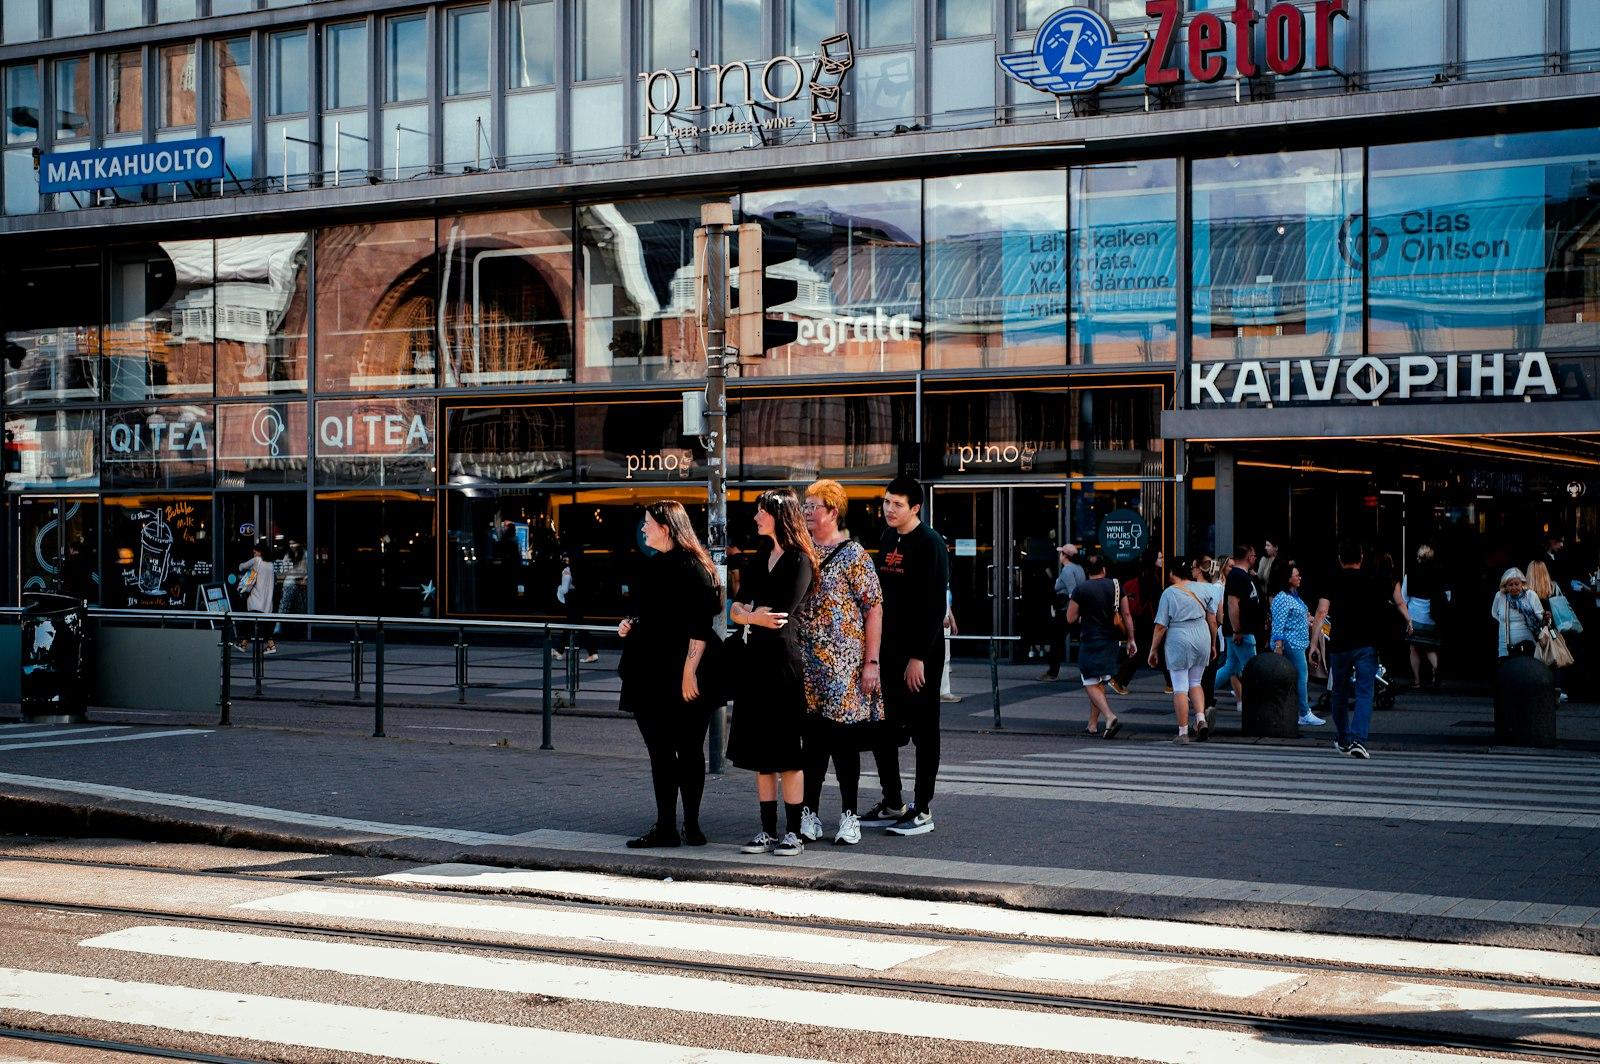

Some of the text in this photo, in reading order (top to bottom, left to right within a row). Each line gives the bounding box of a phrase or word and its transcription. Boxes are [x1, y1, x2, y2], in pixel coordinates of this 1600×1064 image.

[1145, 0, 1349, 85] Zetor
[638, 49, 804, 141] pino
[672, 126, 699, 139] BEER
[709, 121, 753, 135] COFFEE
[763, 117, 795, 130] WINE
[47, 147, 213, 183] MATKAHUOLTO
[1400, 208, 1470, 236] Clas
[1029, 228, 1159, 254] Lähs kaiken
[1401, 236, 1510, 263] Ohlson
[1029, 256, 1057, 275] voi
[795, 306, 910, 354] egrata
[1191, 351, 1558, 404] KAIVOPIHA
[110, 421, 207, 452] QI TEA
[320, 415, 429, 448] QI TEA
[625, 450, 679, 479] pino
[958, 441, 1019, 472] pino
